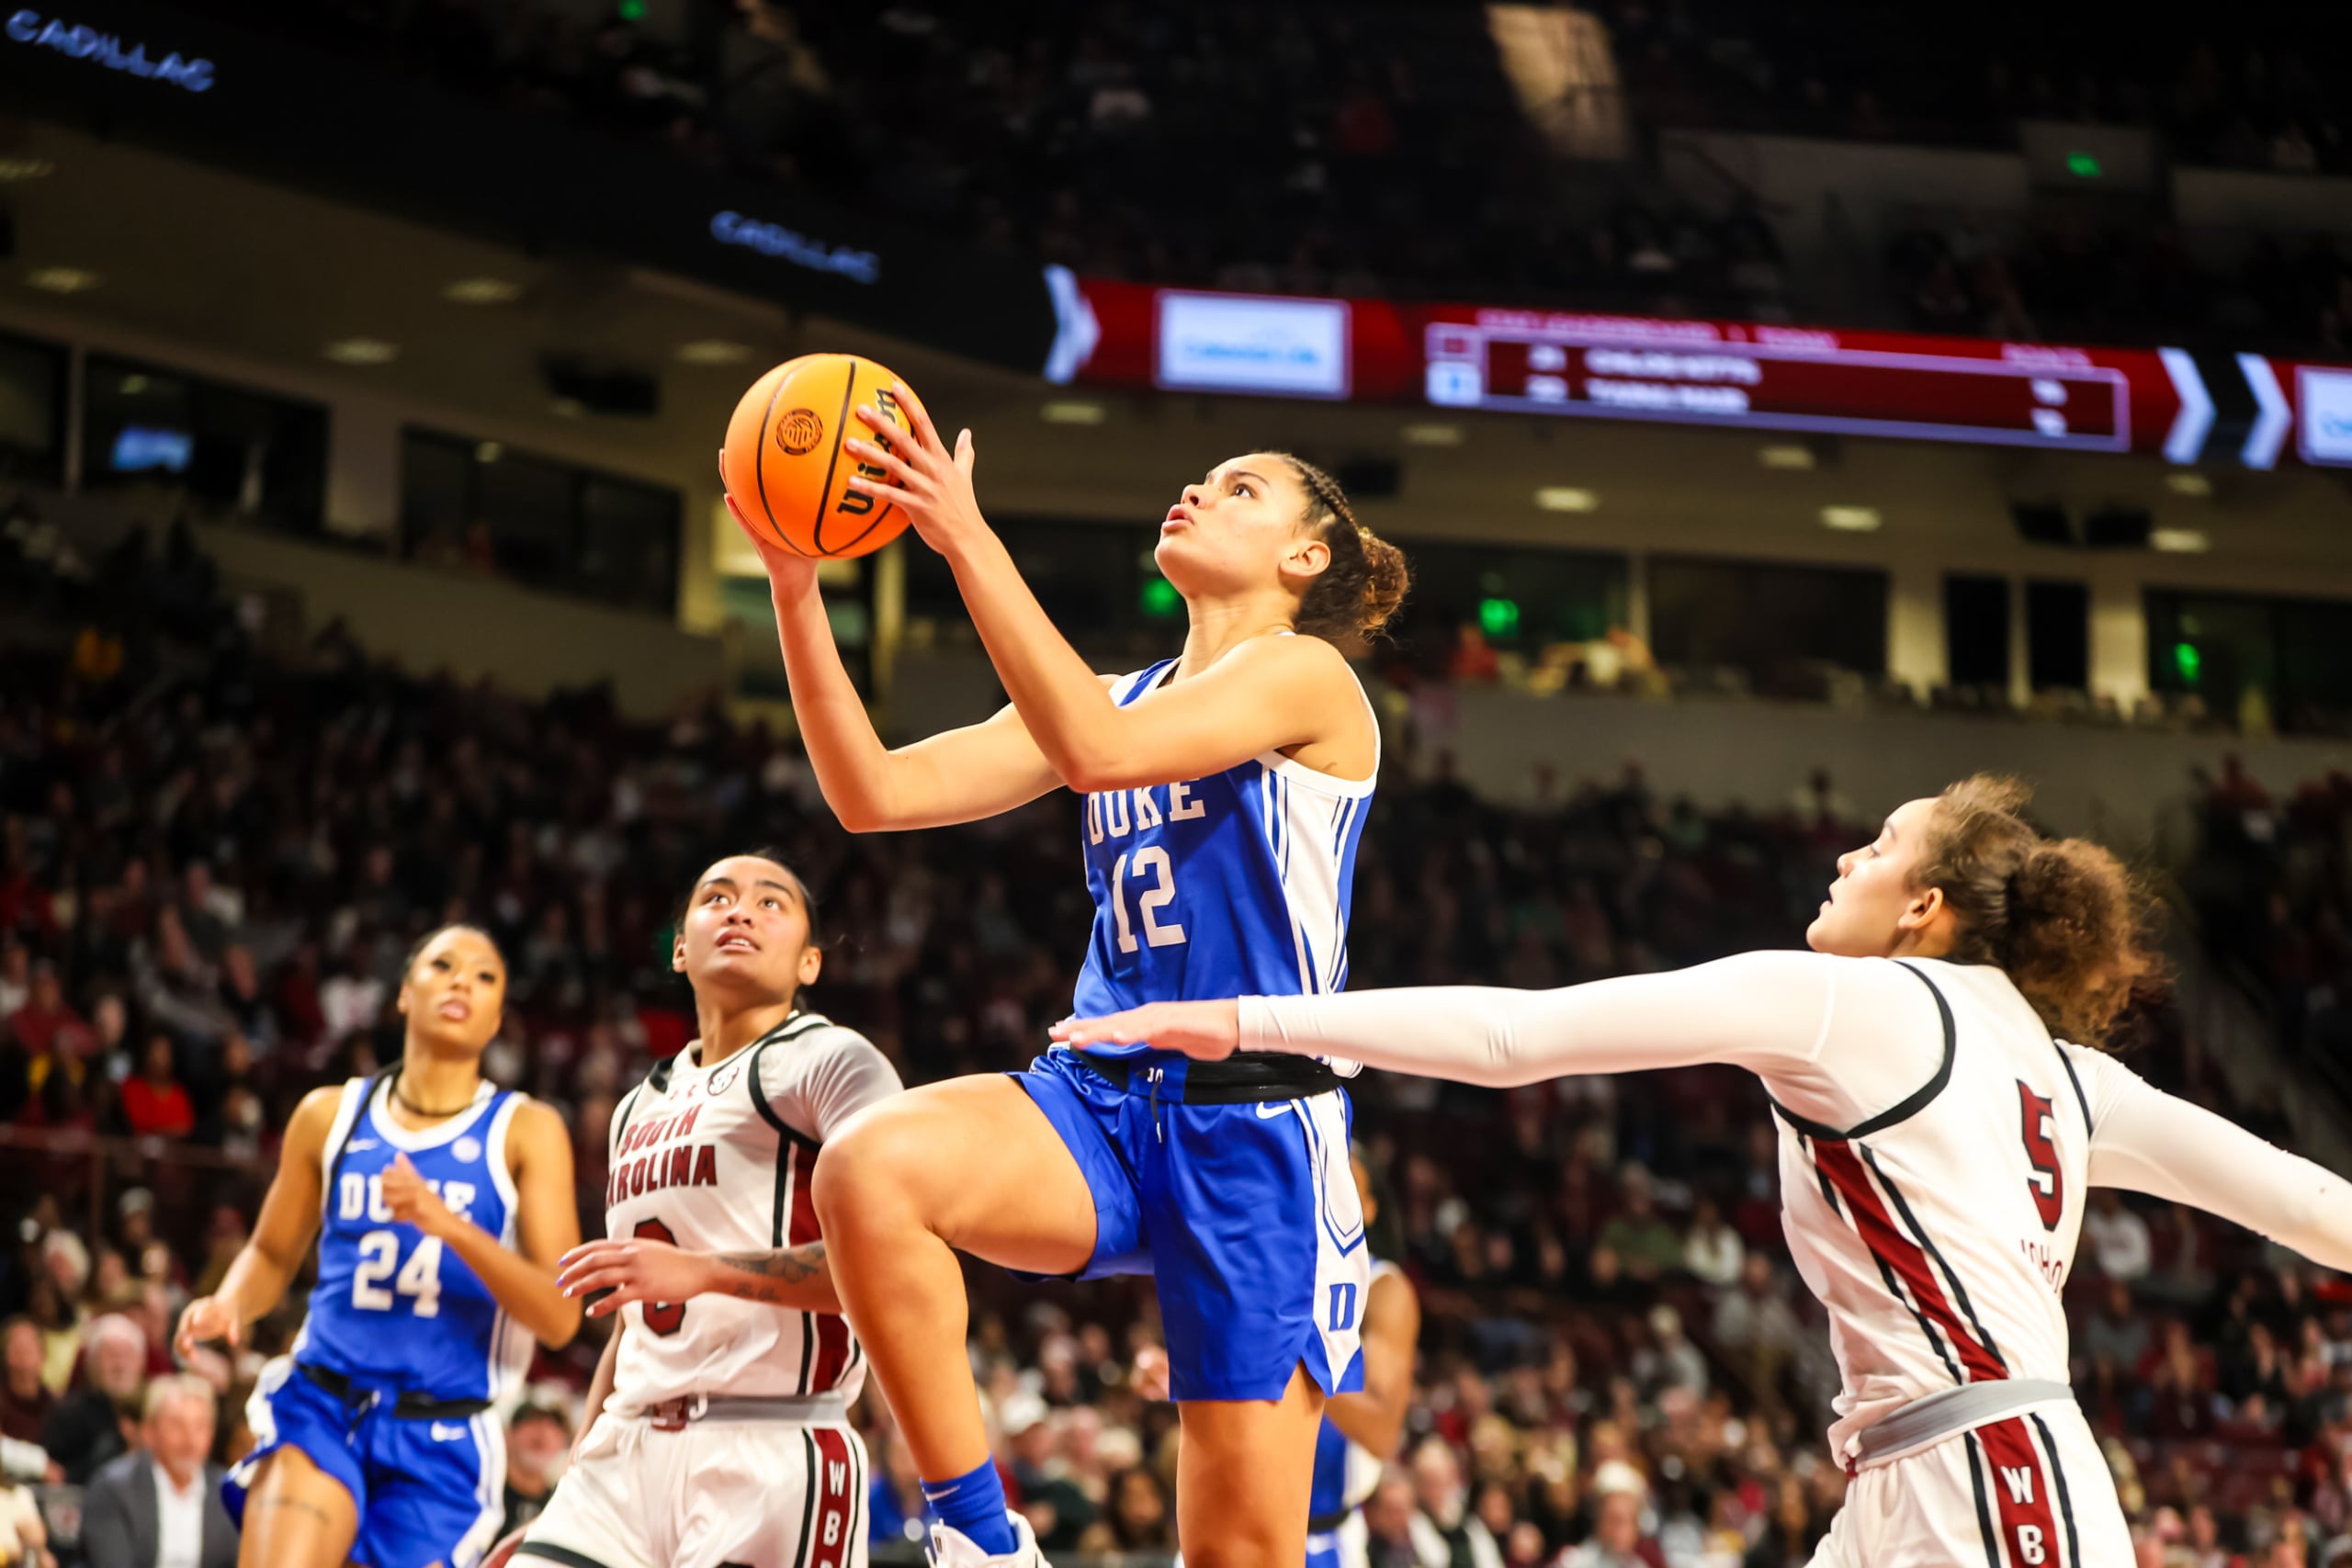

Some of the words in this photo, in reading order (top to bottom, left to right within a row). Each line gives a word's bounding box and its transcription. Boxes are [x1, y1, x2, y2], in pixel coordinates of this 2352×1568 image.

[6, 8, 215, 92] CADILLAC
[1088, 777, 1205, 846] DUKE
[1112, 845, 1187, 953] 12
[339, 1172, 476, 1224] DUE
[605, 1145, 718, 1210] AROLINA
[2016, 1077, 2064, 1233] 5
[352, 1229, 443, 1319] 24
[820, 1459, 846, 1568] WB
